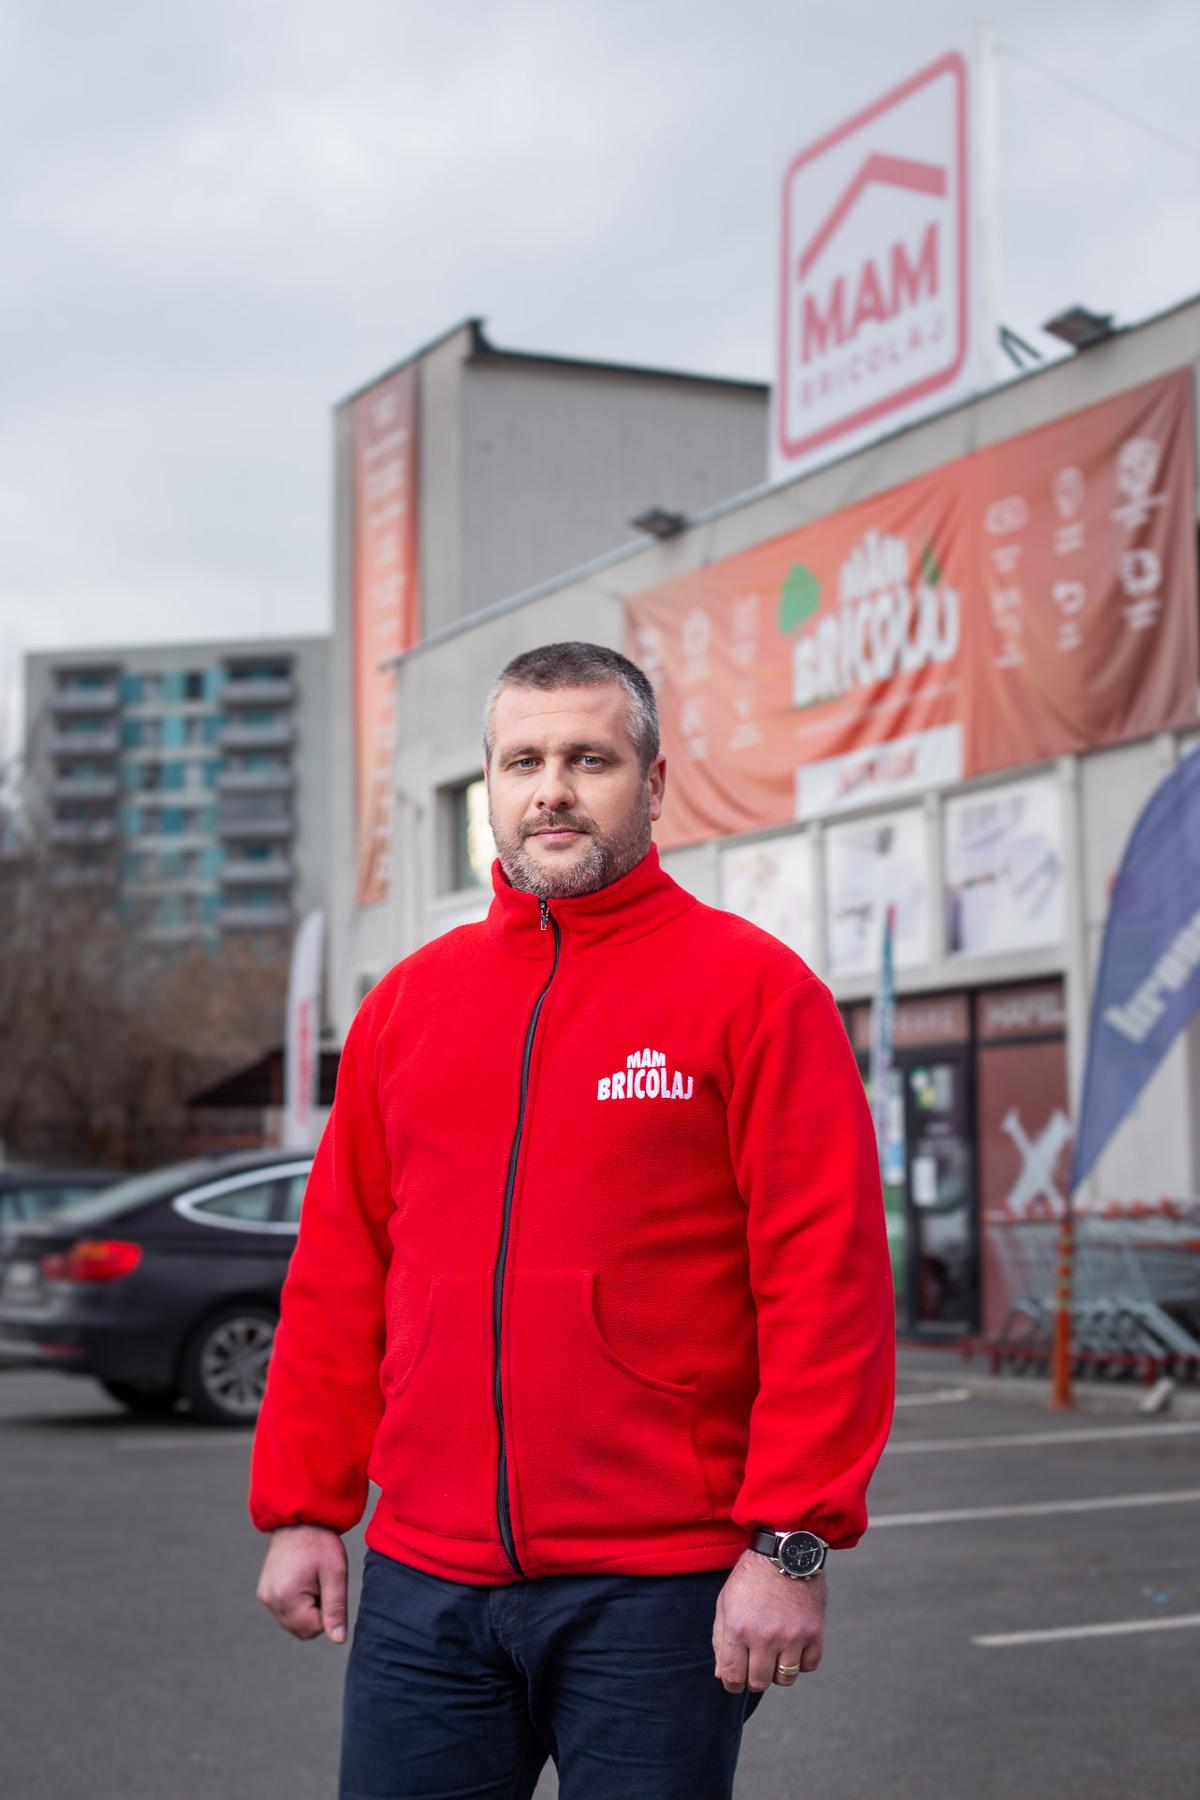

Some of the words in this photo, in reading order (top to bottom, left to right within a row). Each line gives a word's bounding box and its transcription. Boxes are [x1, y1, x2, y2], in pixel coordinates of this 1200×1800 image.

[802, 220, 940, 365] MAM
[792, 582, 961, 706] BRICOLAJ
[597, 1067, 694, 1101] BRICOLAJ
[626, 1047, 666, 1069] MAM
